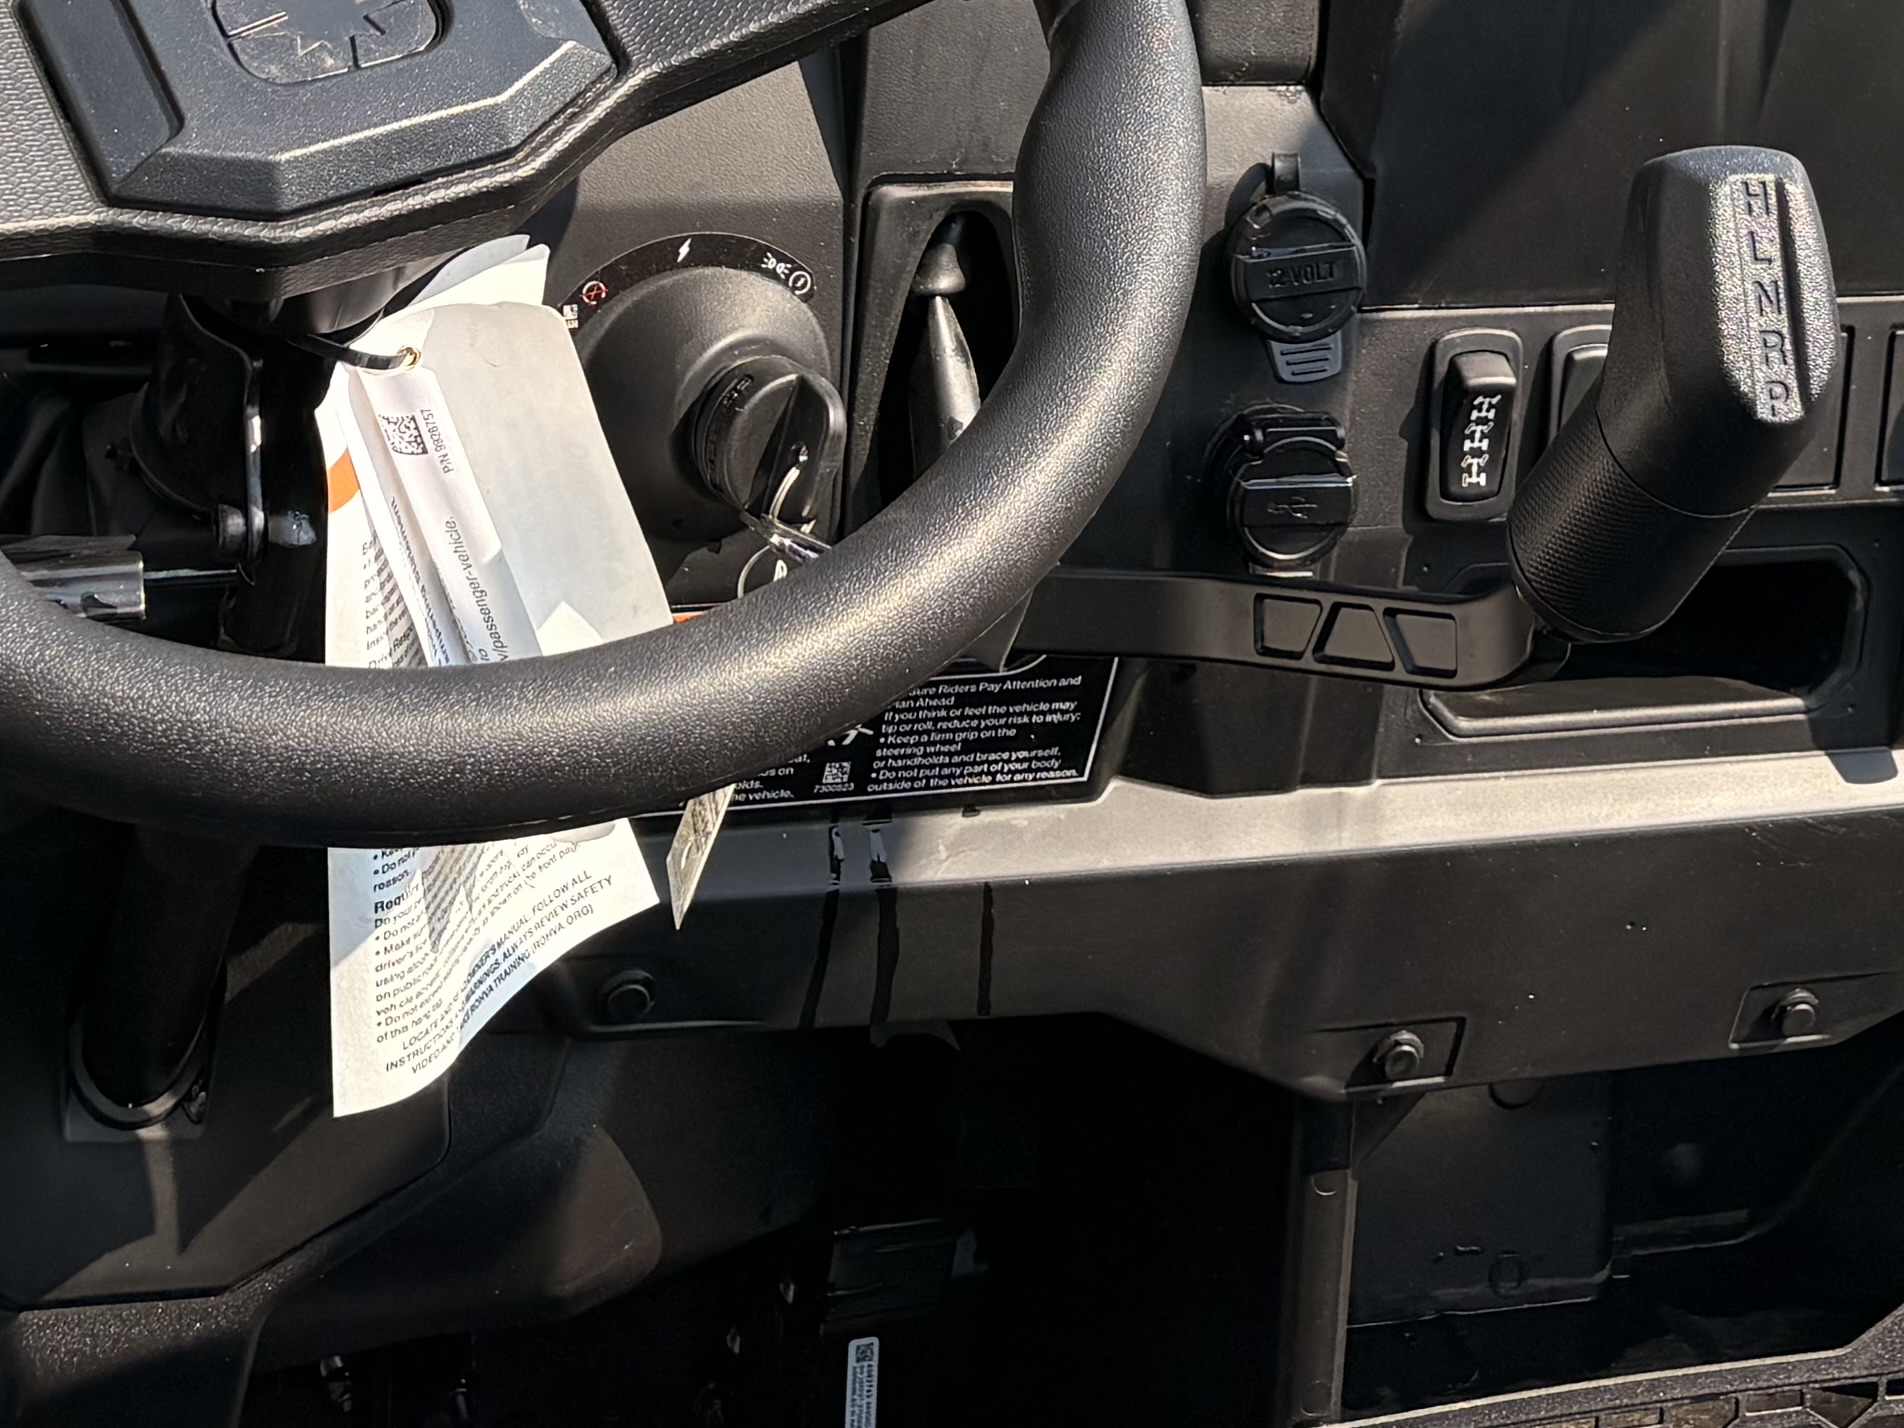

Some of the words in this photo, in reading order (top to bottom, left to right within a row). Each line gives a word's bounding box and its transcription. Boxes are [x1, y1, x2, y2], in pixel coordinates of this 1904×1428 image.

[1291, 262, 1335, 286] VOLT
[938, 685, 976, 693] Riders
[978, 683, 1001, 692] Pay
[1003, 680, 1056, 689] Attention
[1058, 676, 1081, 686] and
[916, 697, 954, 706] Ahead
[919, 709, 946, 718] think
[988, 706, 1006, 714] the
[1008, 702, 1049, 712] vehicle
[1052, 702, 1076, 713] may
[937, 720, 978, 728] reduce
[1008, 715, 1029, 723] risk
[1032, 715, 1043, 723] to
[887, 736, 918, 744] Keep
[955, 732, 978, 741] grip
[997, 728, 1016, 736] the
[926, 743, 960, 752] wheel
[951, 754, 974, 762] and
[976, 752, 1009, 763] brace
[878, 770, 896, 779] Do
[963, 764, 988, 774] part
[990, 762, 1001, 774] of
[1002, 763, 1028, 772] your
[1031, 759, 1060, 768] body
[930, 778, 948, 786] the
[995, 773, 1011, 786] for
[1013, 773, 1034, 784] any
[532, 883, 569, 917] FOLLOW
[571, 869, 592, 887] ALL
[570, 874, 613, 906] SAFETY
